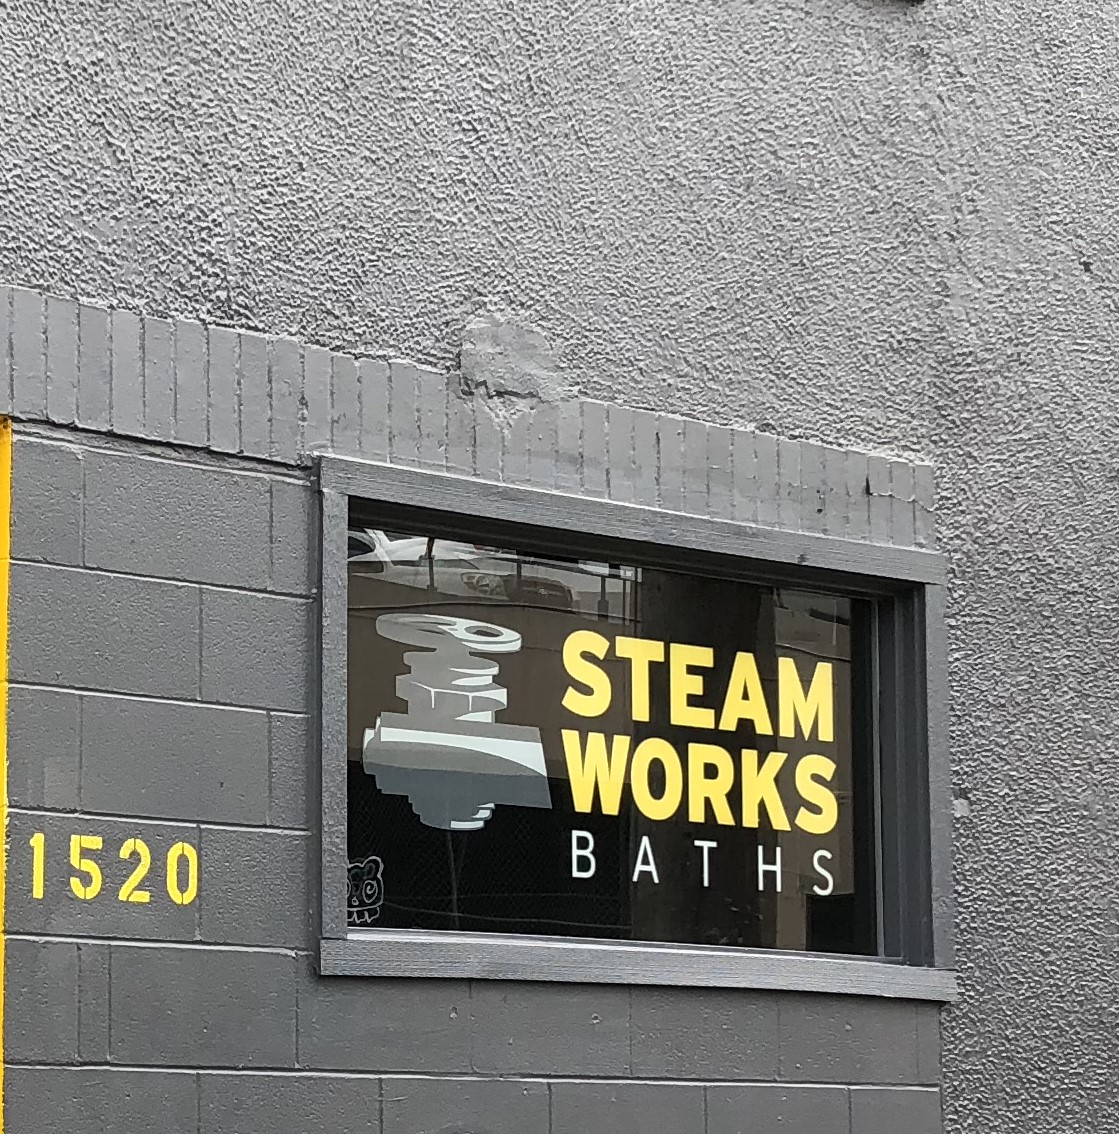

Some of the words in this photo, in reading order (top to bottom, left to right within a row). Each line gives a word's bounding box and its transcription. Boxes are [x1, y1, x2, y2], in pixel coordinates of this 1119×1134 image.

[561, 630, 834, 743] STEAM
[561, 728, 838, 835] WORKS
[29, 832, 198, 905] 1520
[571, 829, 834, 896] BATHS
